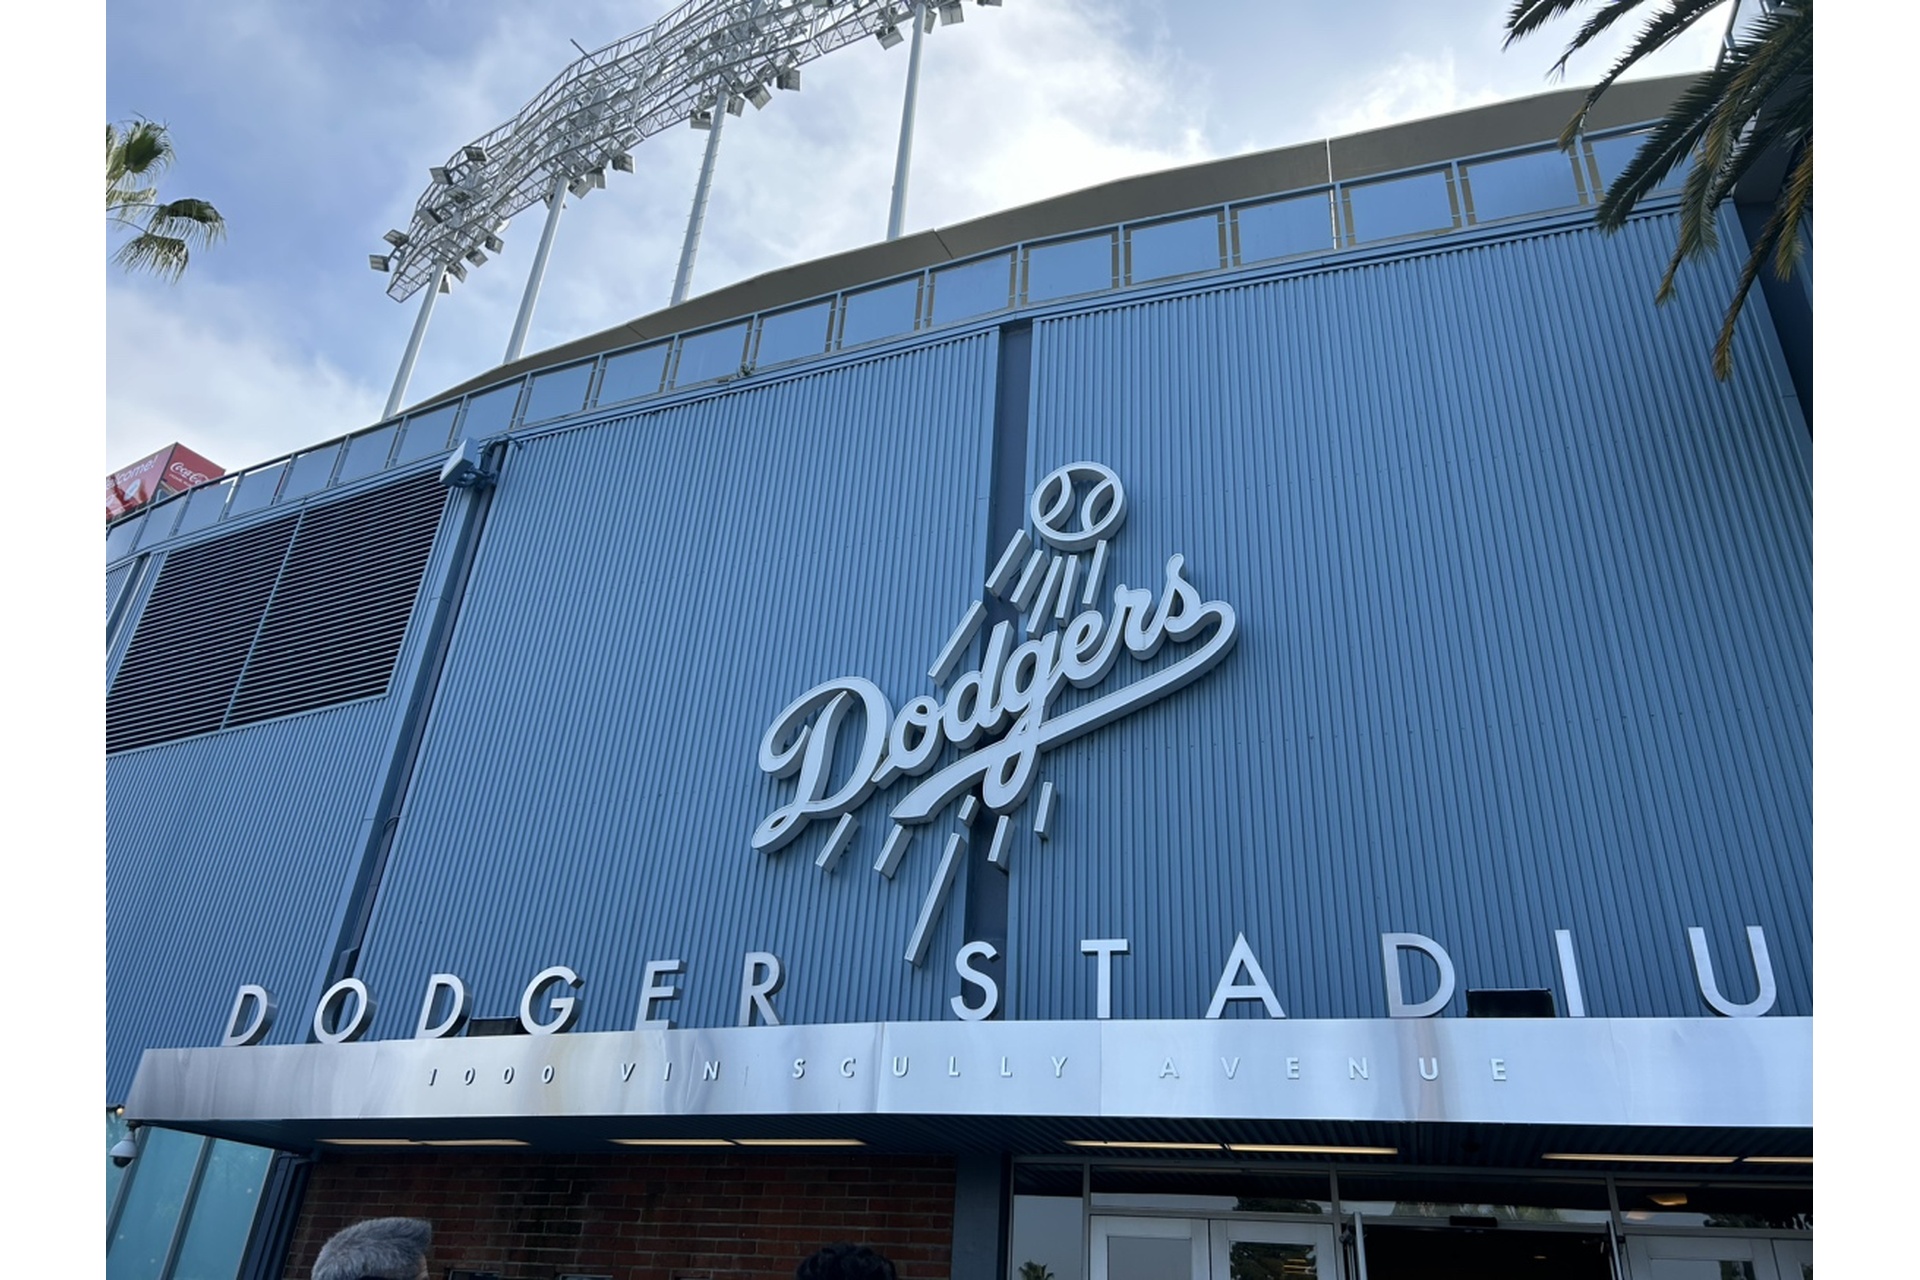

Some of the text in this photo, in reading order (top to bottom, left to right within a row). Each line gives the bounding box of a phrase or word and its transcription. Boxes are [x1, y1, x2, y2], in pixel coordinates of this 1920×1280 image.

[751, 553, 1238, 853] Dodgers
[221, 925, 1778, 1046] DODGER STADIU
[428, 1055, 1508, 1086] 1000 VIN SCULLY AVENUE
